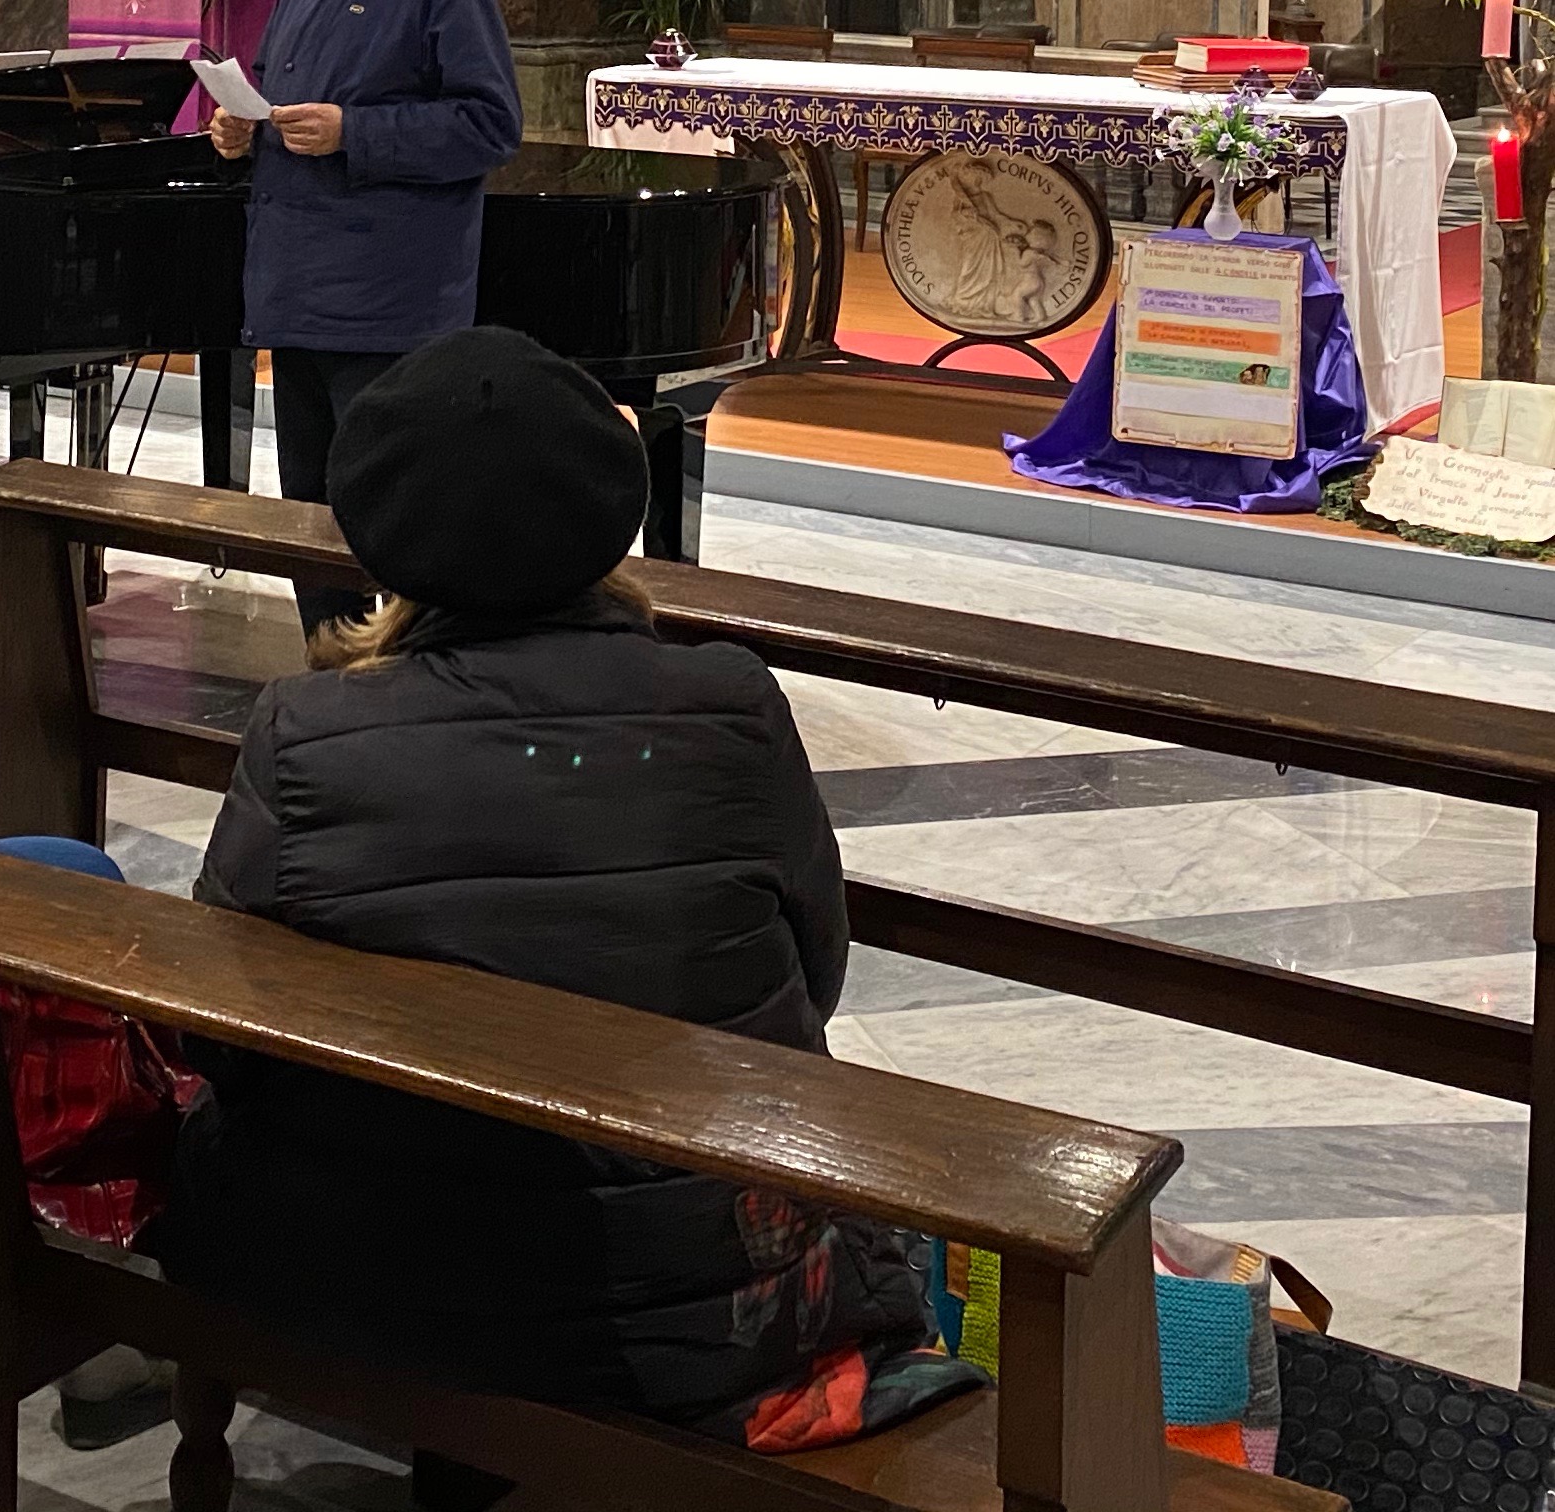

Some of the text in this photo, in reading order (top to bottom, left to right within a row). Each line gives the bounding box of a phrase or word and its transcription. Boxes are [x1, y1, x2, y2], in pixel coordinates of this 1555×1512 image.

[997, 158, 1091, 309] CORPVS HIC QVIESCIT
